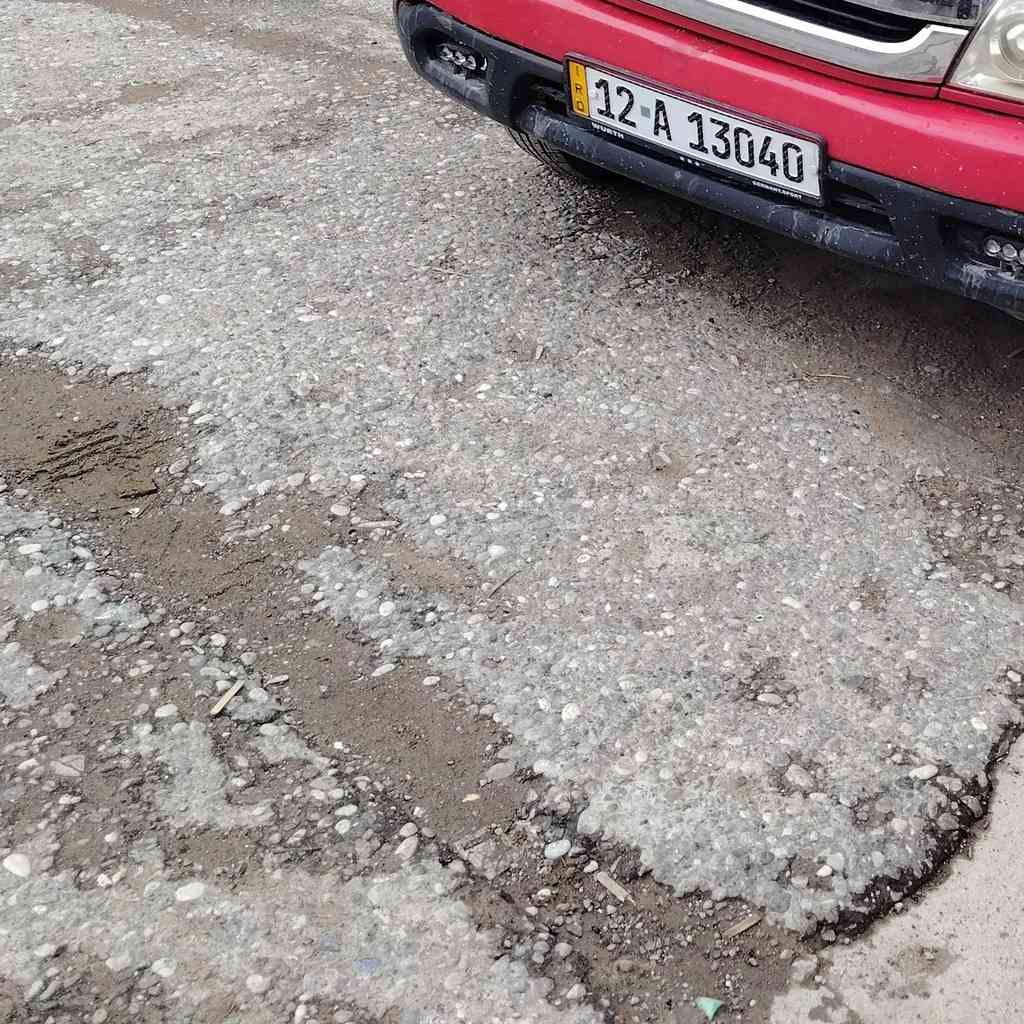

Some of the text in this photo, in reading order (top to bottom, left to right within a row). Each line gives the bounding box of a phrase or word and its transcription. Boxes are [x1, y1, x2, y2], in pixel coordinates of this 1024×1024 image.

[595, 79, 804, 183] 12 A 13040
